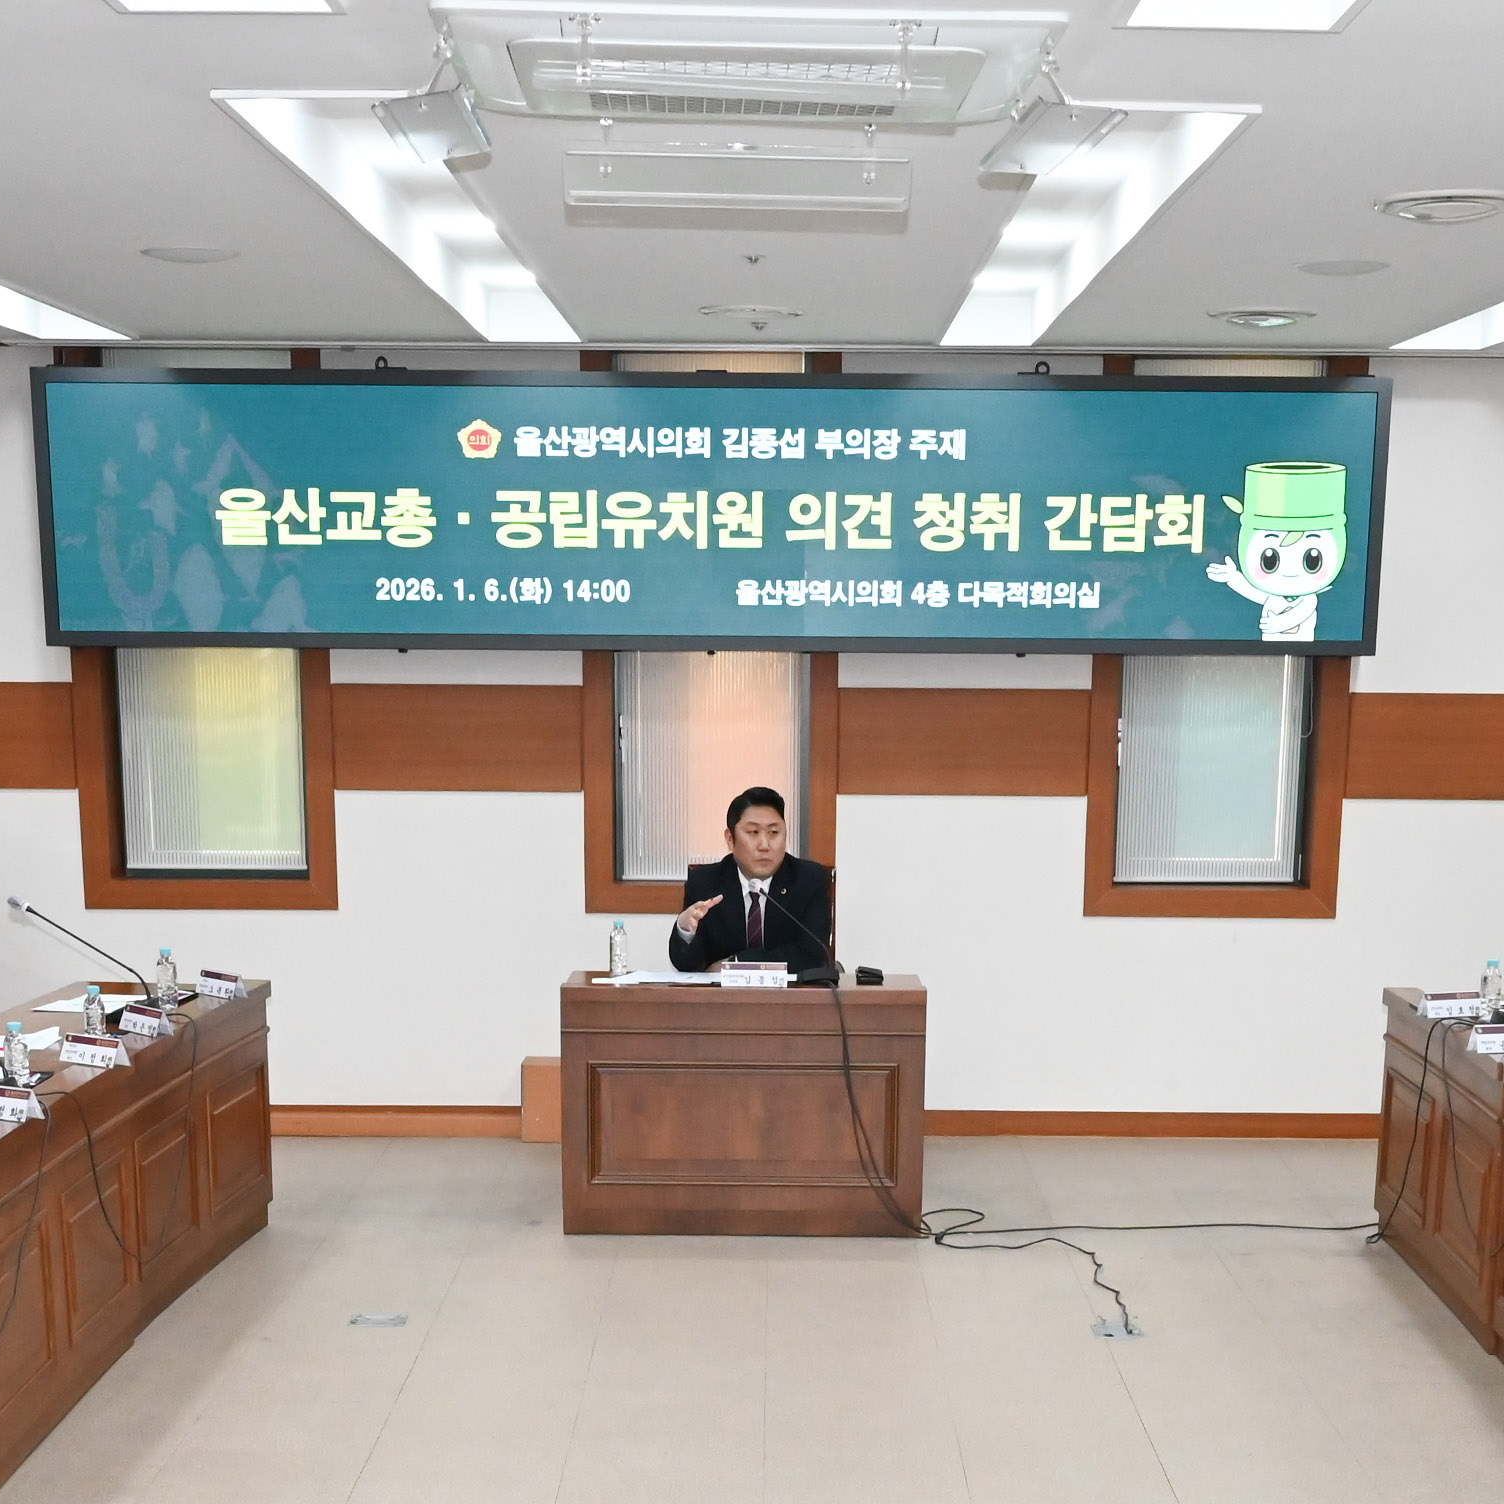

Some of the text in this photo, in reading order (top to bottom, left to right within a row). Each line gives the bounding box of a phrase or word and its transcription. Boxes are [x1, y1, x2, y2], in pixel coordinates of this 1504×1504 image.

[468, 434, 490, 446] 의회
[513, 427, 967, 461] 울산광역시의회 김종섭 부의장 주재
[215, 488, 437, 548] 울산교총
[491, 489, 764, 549] 공립유치원
[785, 491, 893, 553] 의견
[912, 492, 1022, 553] 청취
[1044, 493, 1205, 554] 간담회
[376, 577, 631, 604] 2026. 1. 6.(화) 14:00
[736, 579, 1101, 609] 울산광역시의회 4층 다목적회의실
